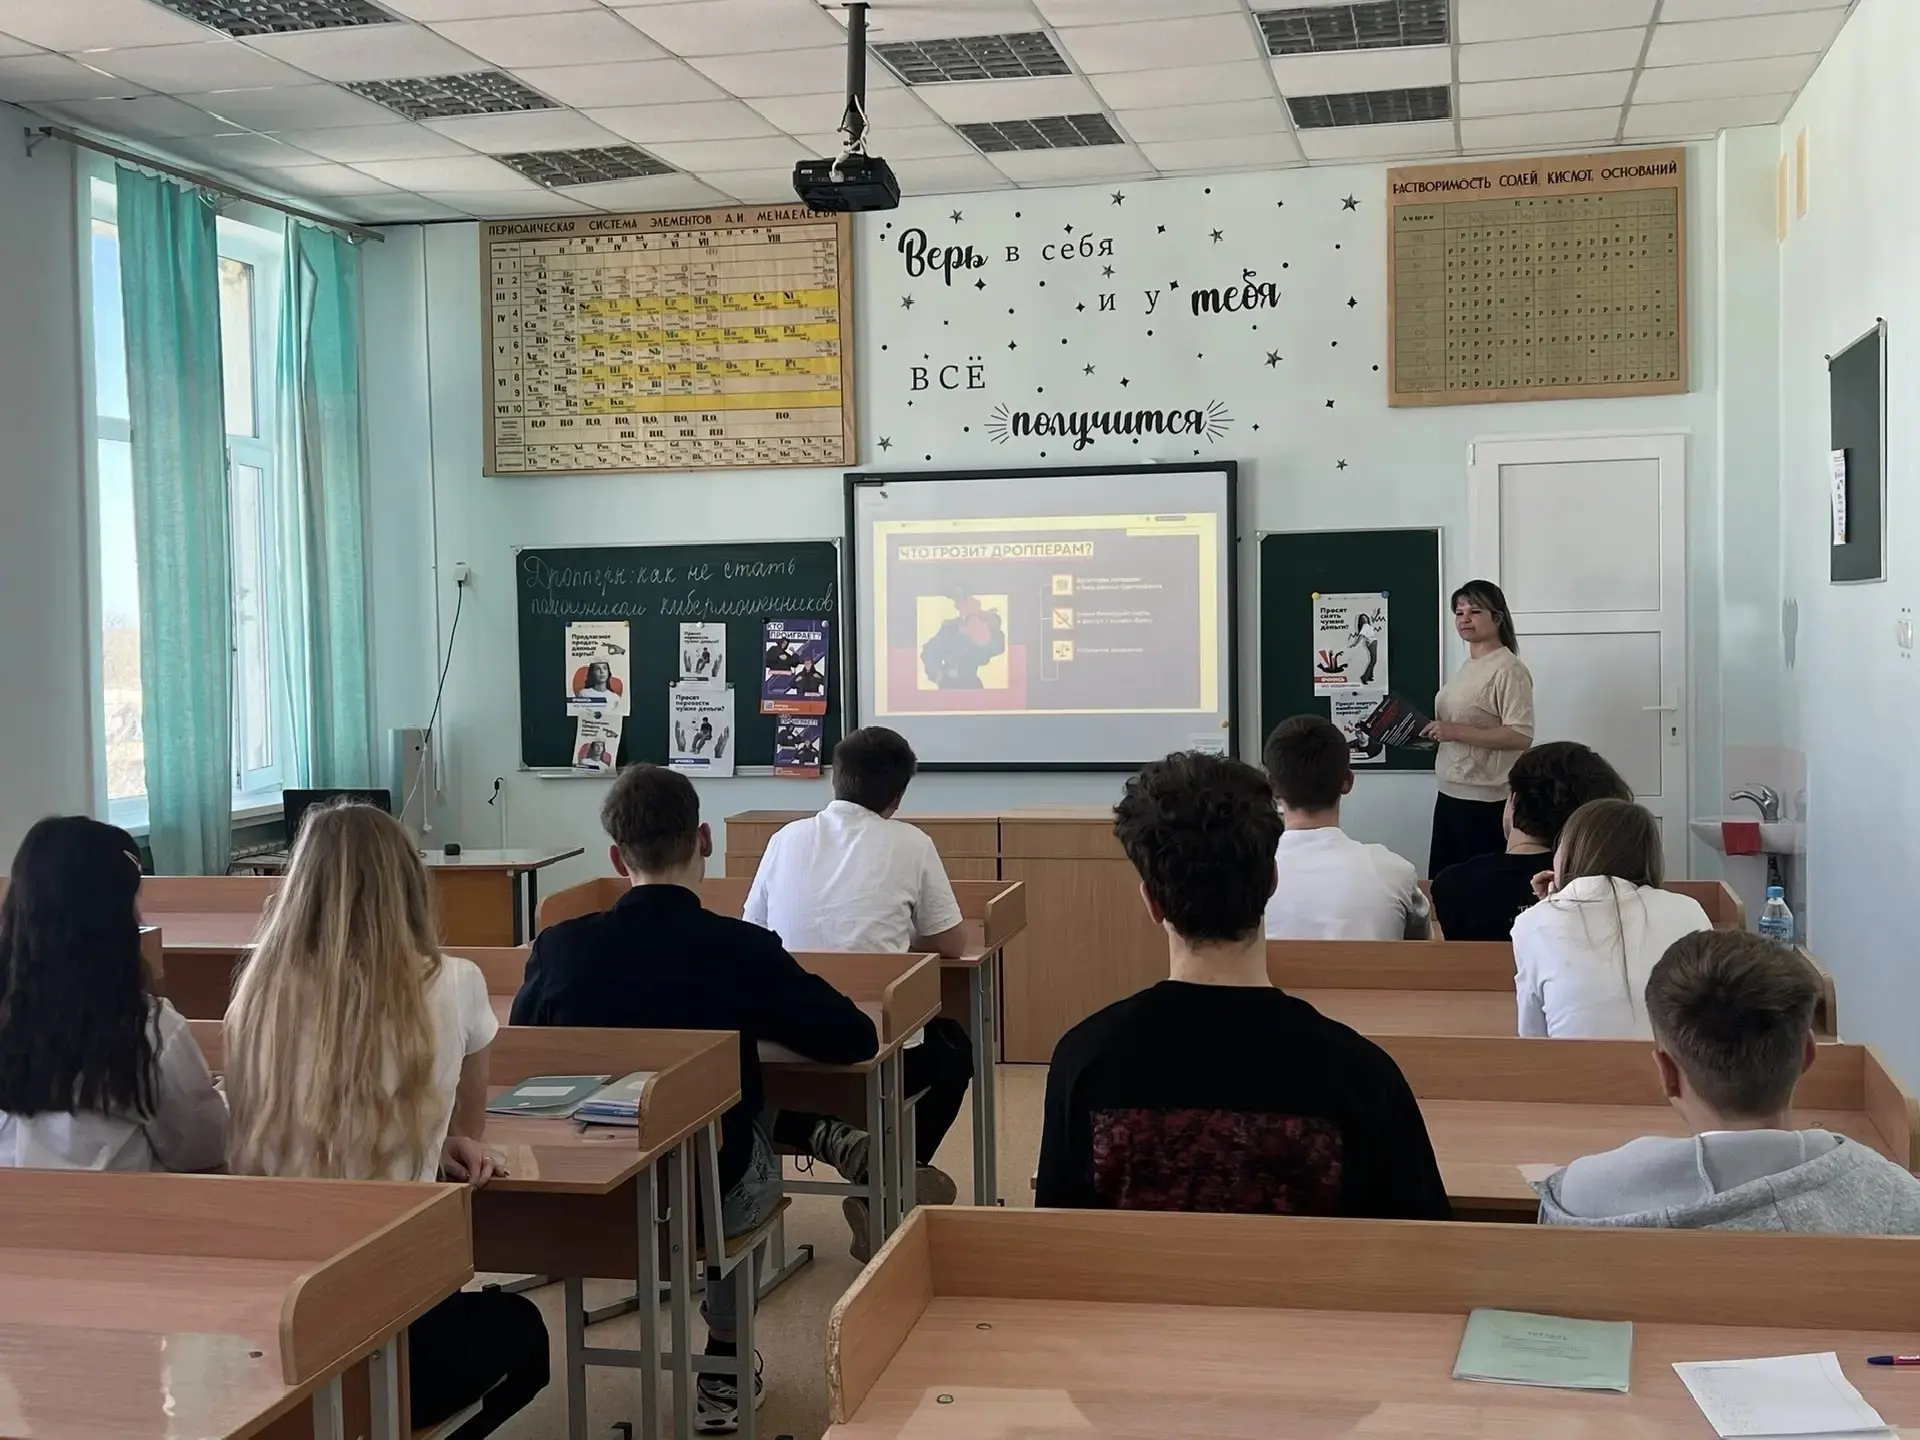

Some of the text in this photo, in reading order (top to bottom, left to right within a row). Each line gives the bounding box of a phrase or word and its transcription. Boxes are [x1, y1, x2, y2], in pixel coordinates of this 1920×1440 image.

[1393, 176, 1491, 194] РАСТВОРИМОСТЬ
[1601, 160, 1677, 180] ОСНОВАНИЙ
[488, 222, 575, 236] ПЕРИОДИЧЕСКАЯ
[589, 219, 637, 230] СИСТЕМА
[650, 214, 712, 227] ЭЛЕМЕНТОВ
[898, 228, 1114, 286] Верь в себя
[1099, 268, 1281, 316] и у тебя
[910, 356, 986, 391] ВСЁ
[497, 405, 509, 413] VII
[513, 404, 521, 413] 10
[1012, 408, 1208, 450] получится
[900, 543, 1092, 559] ЧТО ГРОЗИТ ДРОППЕРАМ?
[688, 563, 714, 580] не
[724, 558, 796, 578] стать
